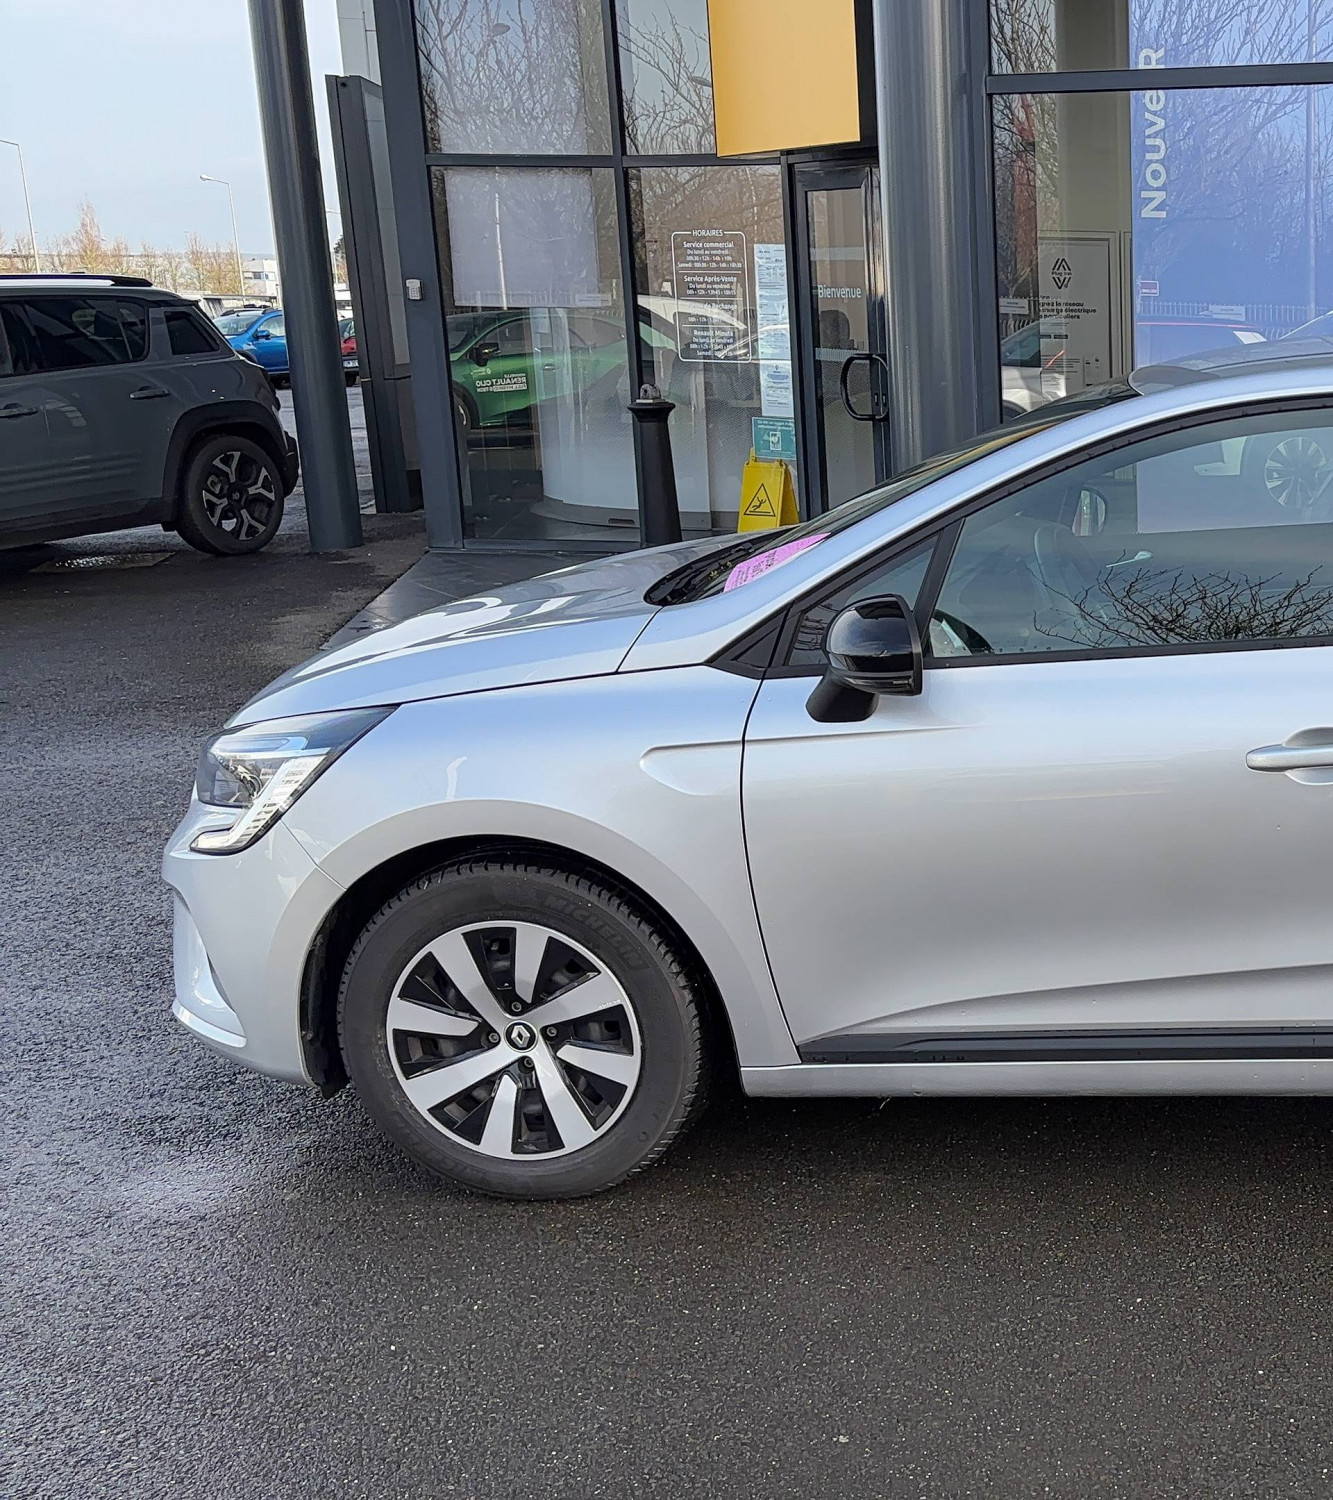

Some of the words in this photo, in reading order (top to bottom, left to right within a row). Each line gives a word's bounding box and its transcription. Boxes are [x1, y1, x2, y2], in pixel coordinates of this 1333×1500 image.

[692, 229, 724, 237] HORAIRES
[704, 275, 737, 283] Après-Vente
[817, 284, 862, 298] Bienvenue
[693, 329, 714, 337] Renault
[714, 329, 734, 337] Minute
